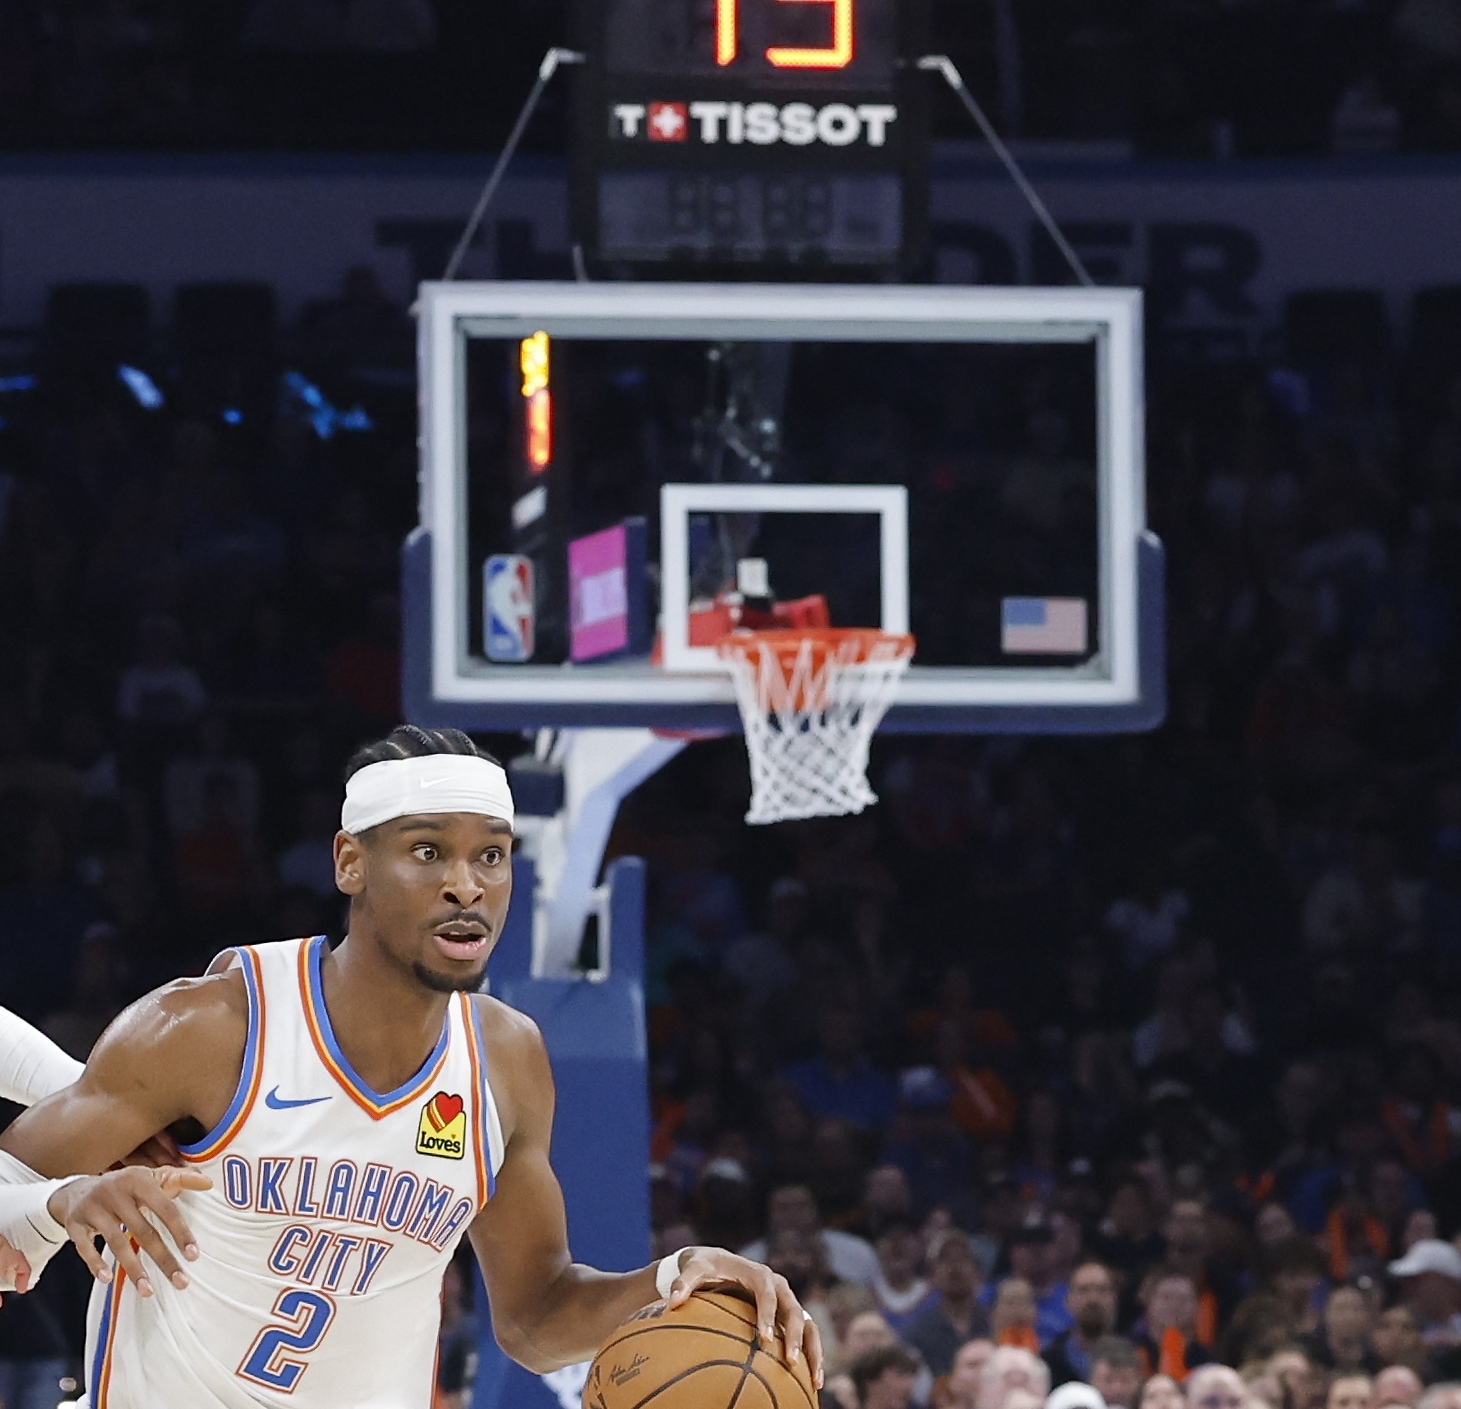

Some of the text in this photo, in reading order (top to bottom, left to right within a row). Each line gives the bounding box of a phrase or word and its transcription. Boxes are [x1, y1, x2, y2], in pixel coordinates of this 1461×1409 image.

[689, 101, 898, 147] TISSOT
[222, 1154, 473, 1253] OKLAHOMA
[267, 1223, 394, 1296] CITY
[235, 1286, 337, 1395] 2
